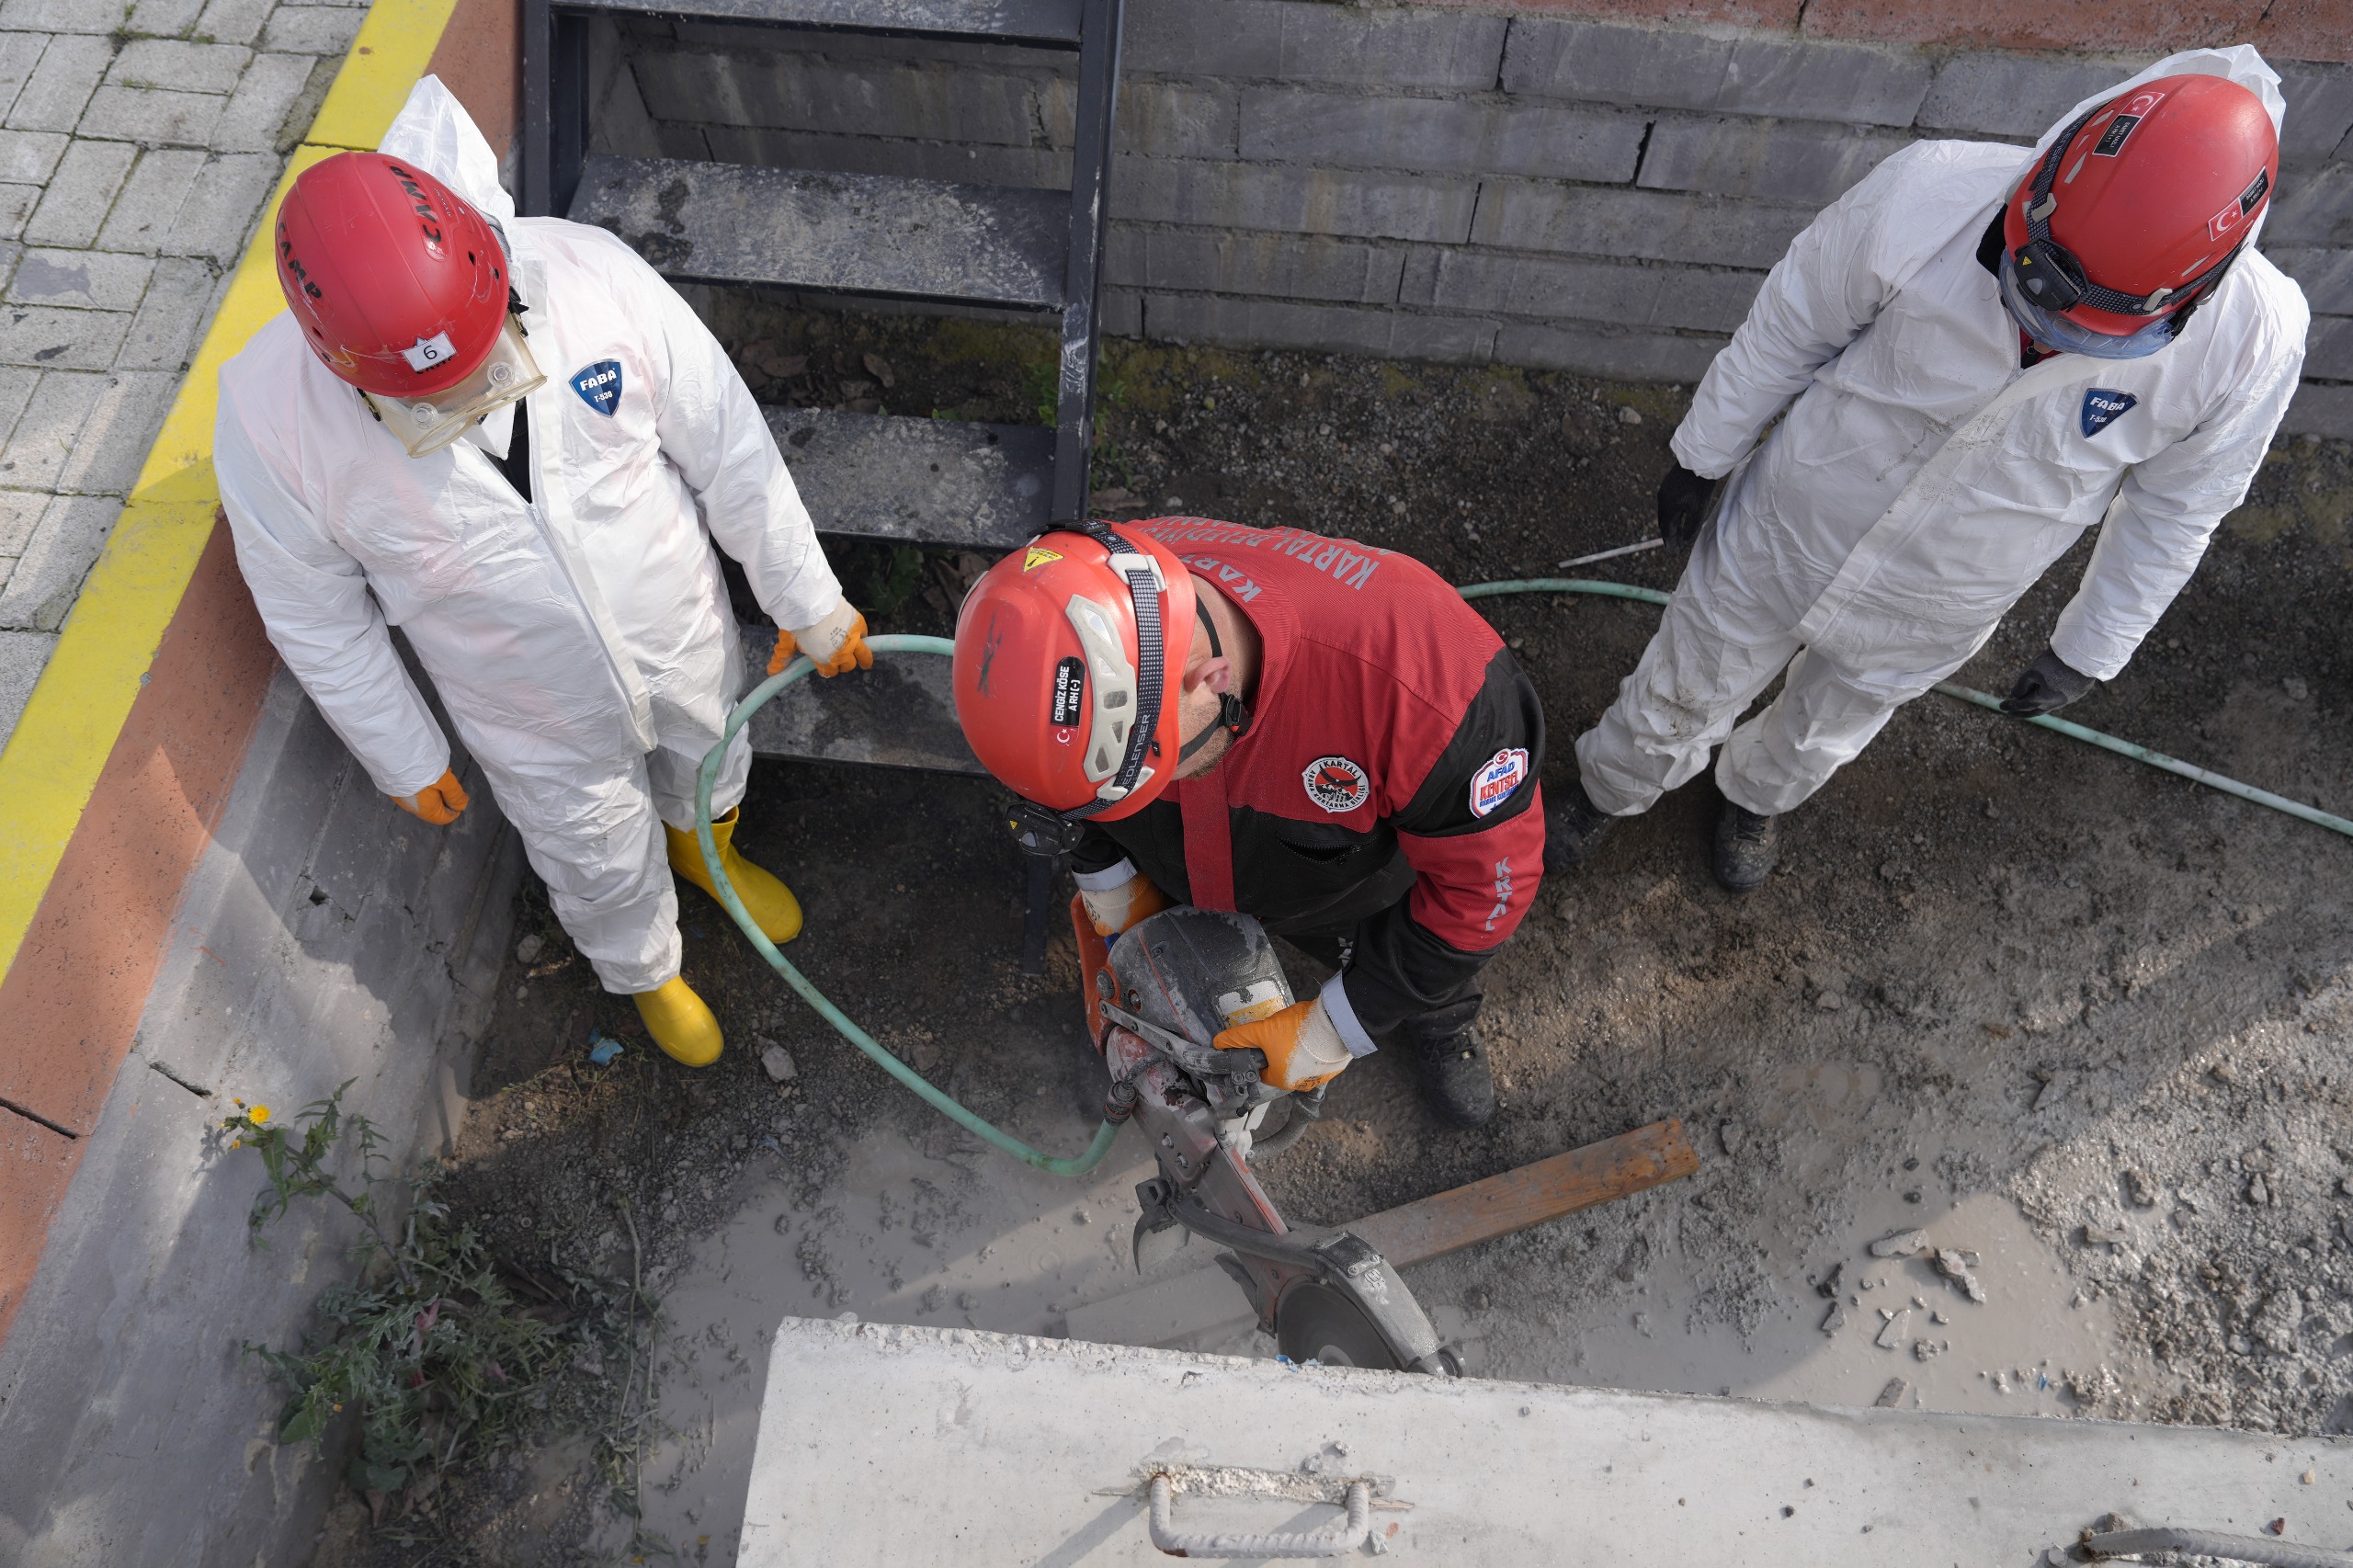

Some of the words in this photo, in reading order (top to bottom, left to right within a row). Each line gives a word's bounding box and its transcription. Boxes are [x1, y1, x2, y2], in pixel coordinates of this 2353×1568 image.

[390, 165, 441, 243] CAMP
[278, 222, 323, 299] CAMP
[423, 345, 438, 360] 6
[579, 369, 617, 392] FABA
[594, 391, 613, 403] T-530
[2089, 396, 2126, 411] FABA
[1271, 537, 1380, 590] KARTAL
[1057, 665, 1070, 690] KÖSE
[1054, 690, 1066, 722] CENGİZ
[1121, 714, 1151, 786] EDLENSER
[1324, 760, 1358, 777] KARTAL
[1486, 761, 1516, 782] AFAD
[1307, 770, 1316, 791] ARAMA
[1313, 793, 1349, 809] KURTARMA
